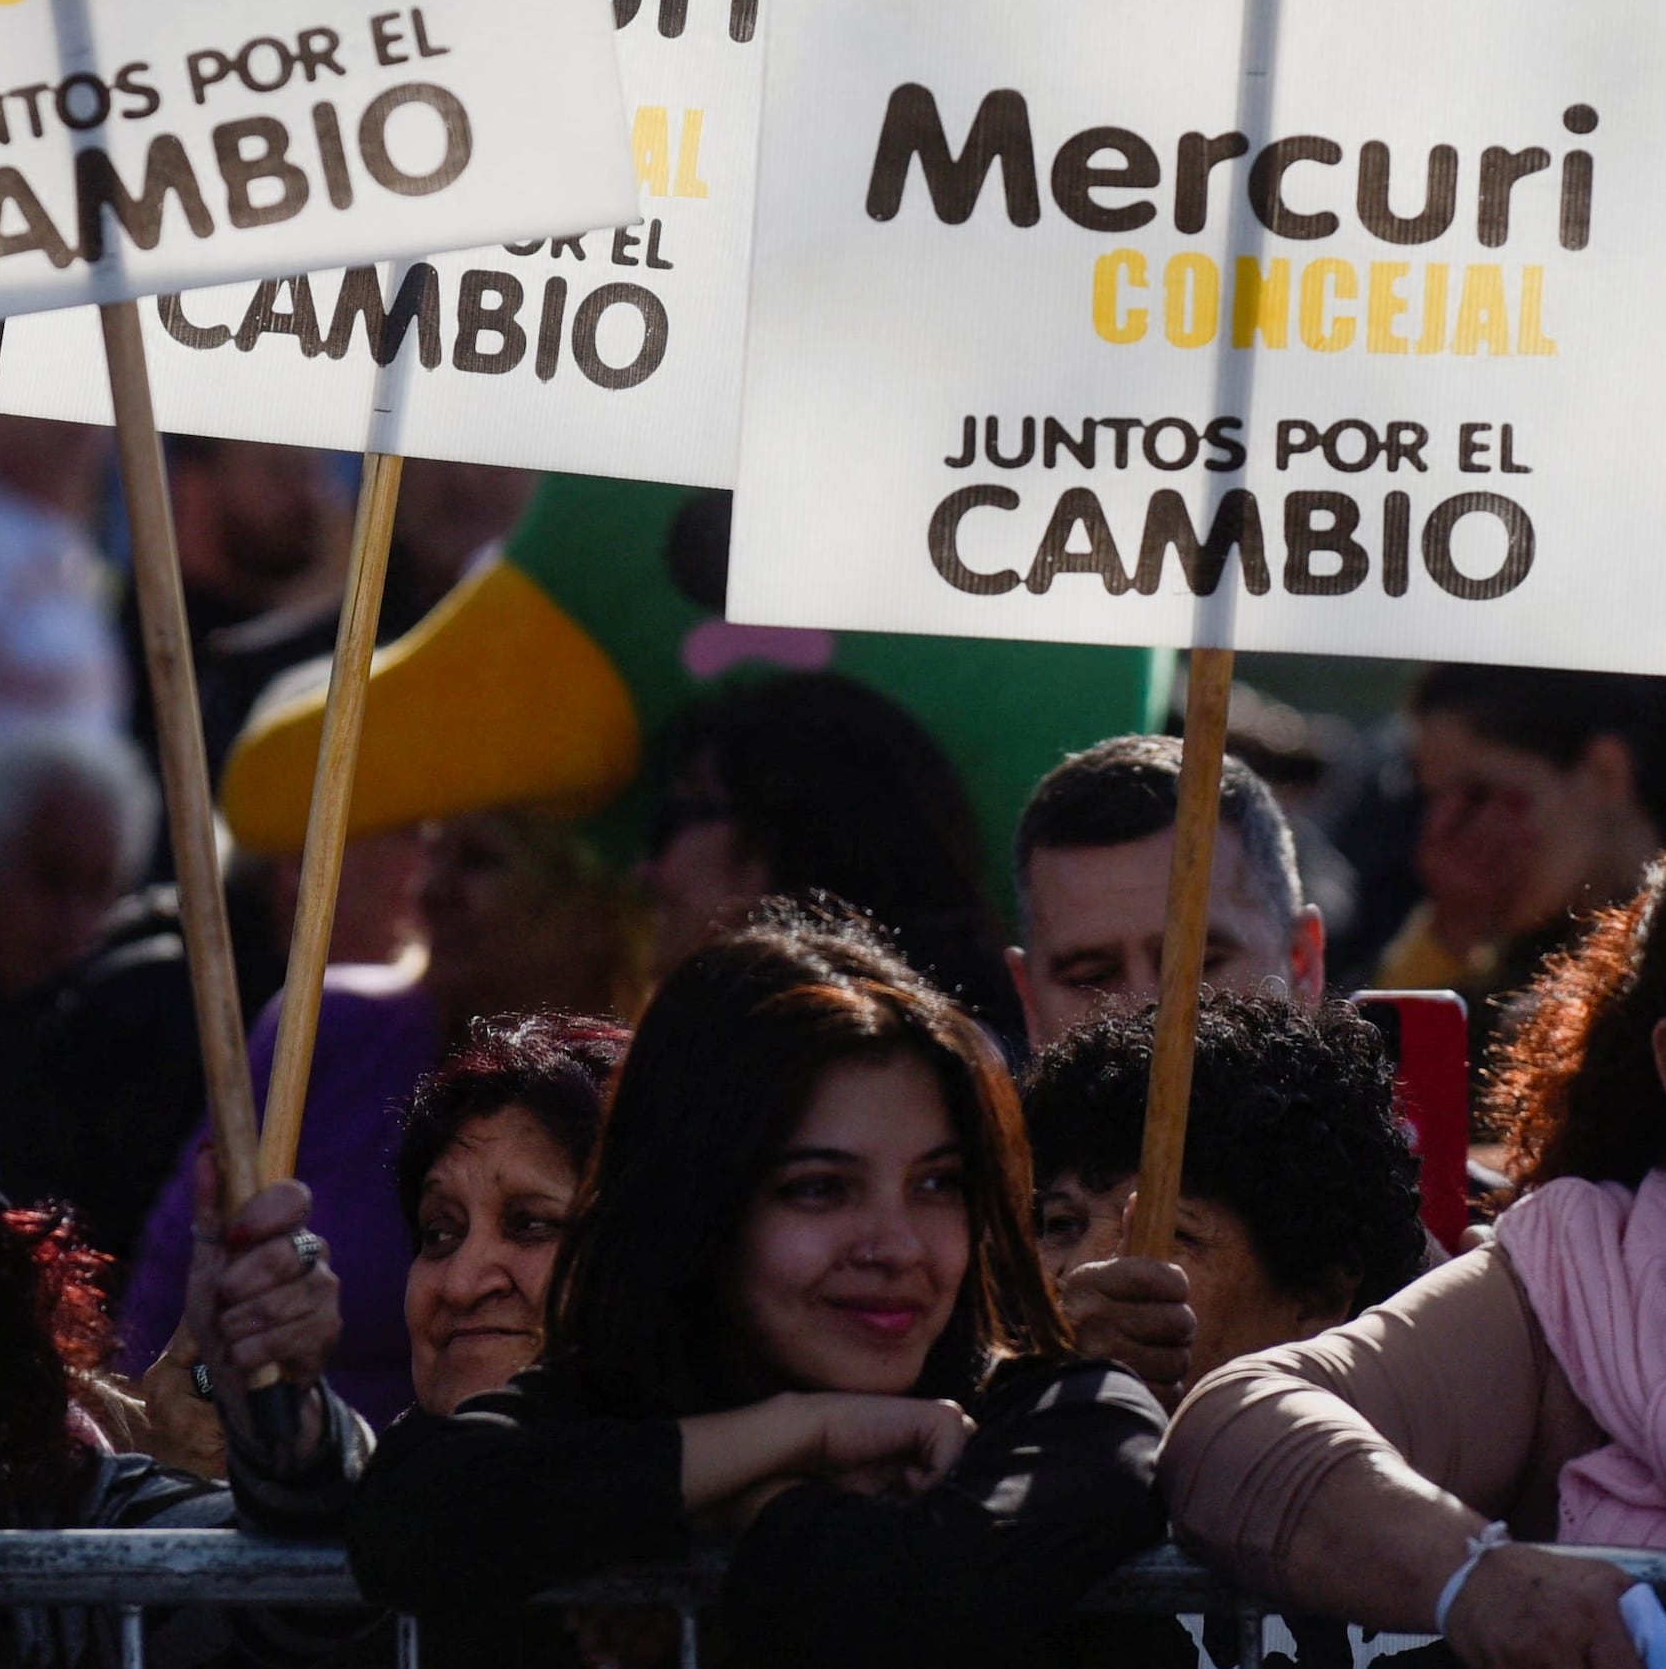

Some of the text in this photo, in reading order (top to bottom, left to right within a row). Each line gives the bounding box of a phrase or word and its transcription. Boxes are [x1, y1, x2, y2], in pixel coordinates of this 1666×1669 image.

[187, 26, 346, 106] POR
[370, 7, 451, 67] EL
[865, 82, 1600, 250] Mercuri
[1091, 248, 1558, 356] CONCEJAL
[944, 415, 1532, 474] JUNTOS POR EL
[928, 484, 1536, 601] CAMBIO
